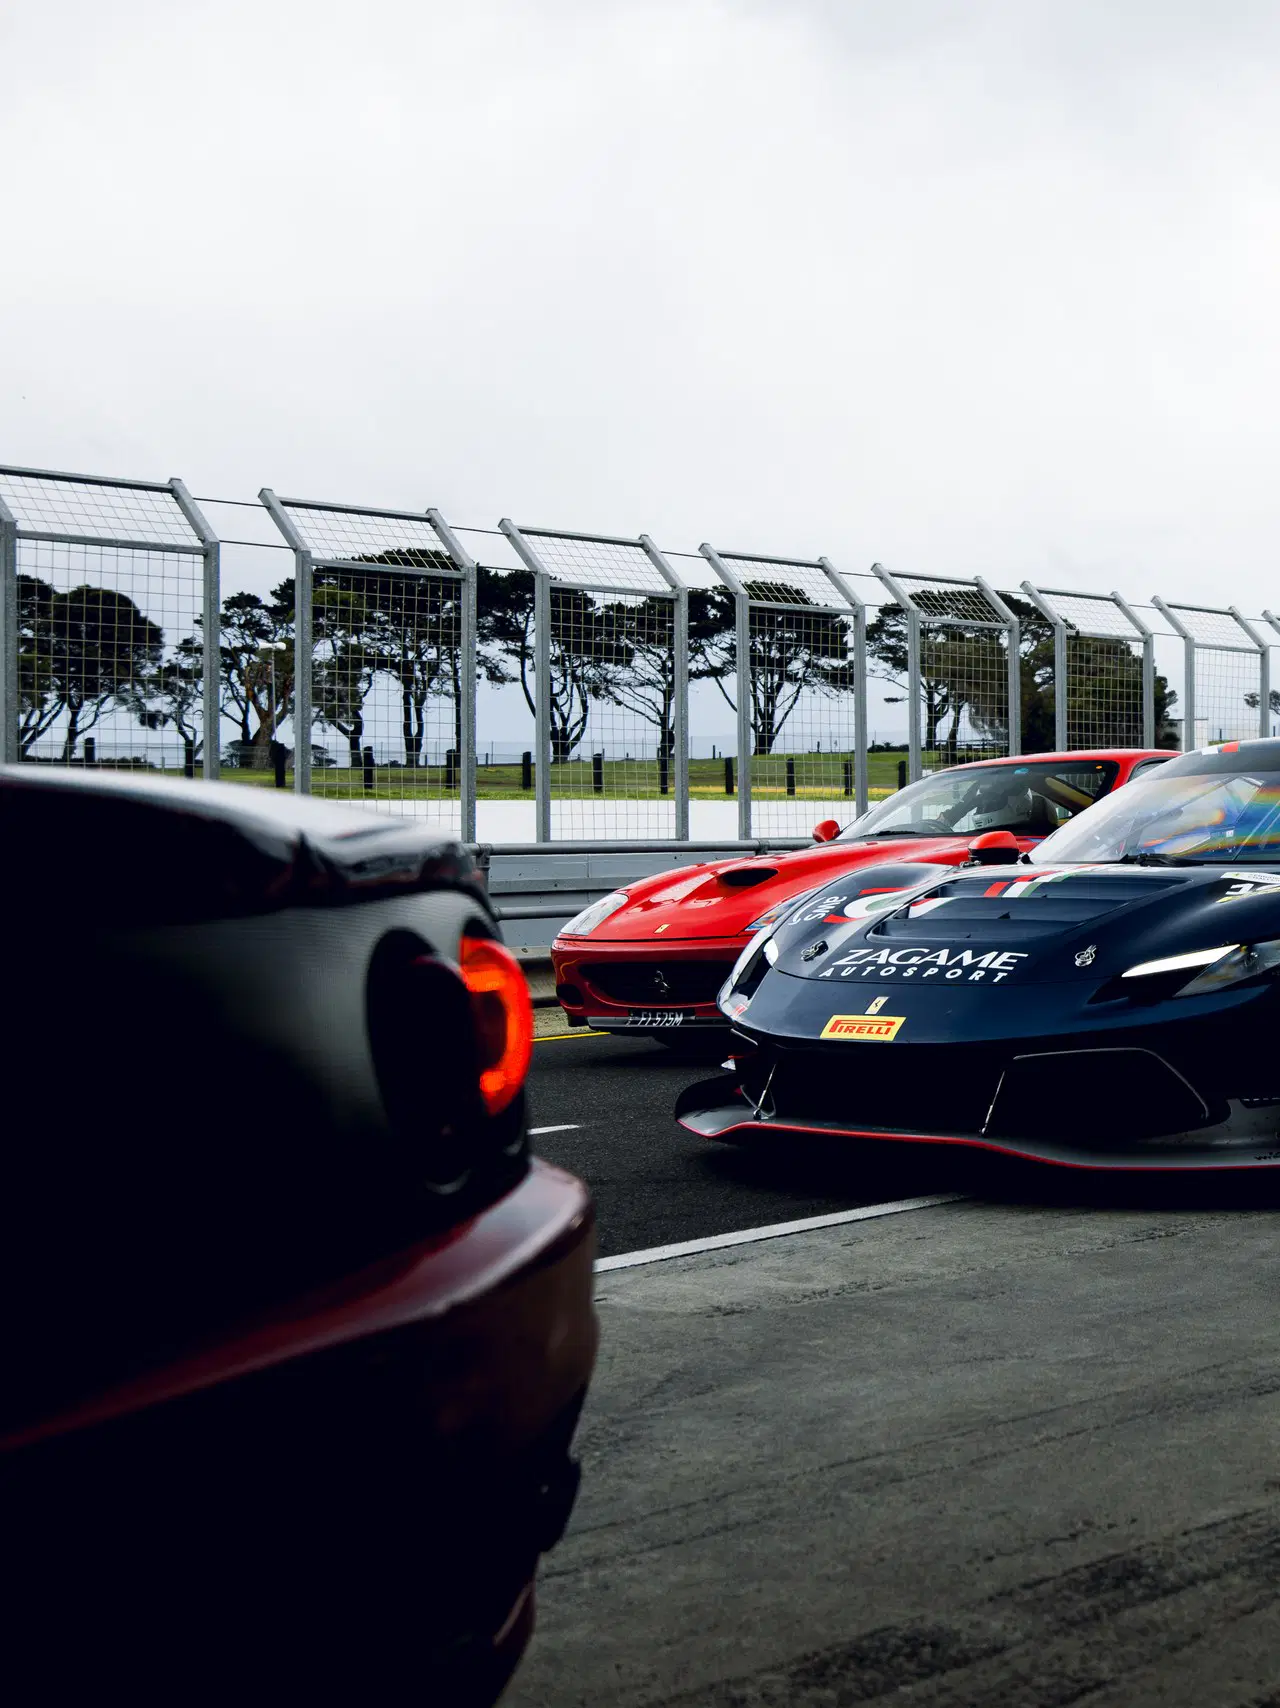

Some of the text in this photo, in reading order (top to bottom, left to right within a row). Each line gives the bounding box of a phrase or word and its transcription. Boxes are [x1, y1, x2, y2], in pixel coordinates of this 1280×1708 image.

[832, 948, 1029, 971] ZAGAME
[818, 966, 1009, 983] AUTOSPORT
[829, 1018, 896, 1037] PIRELLI
